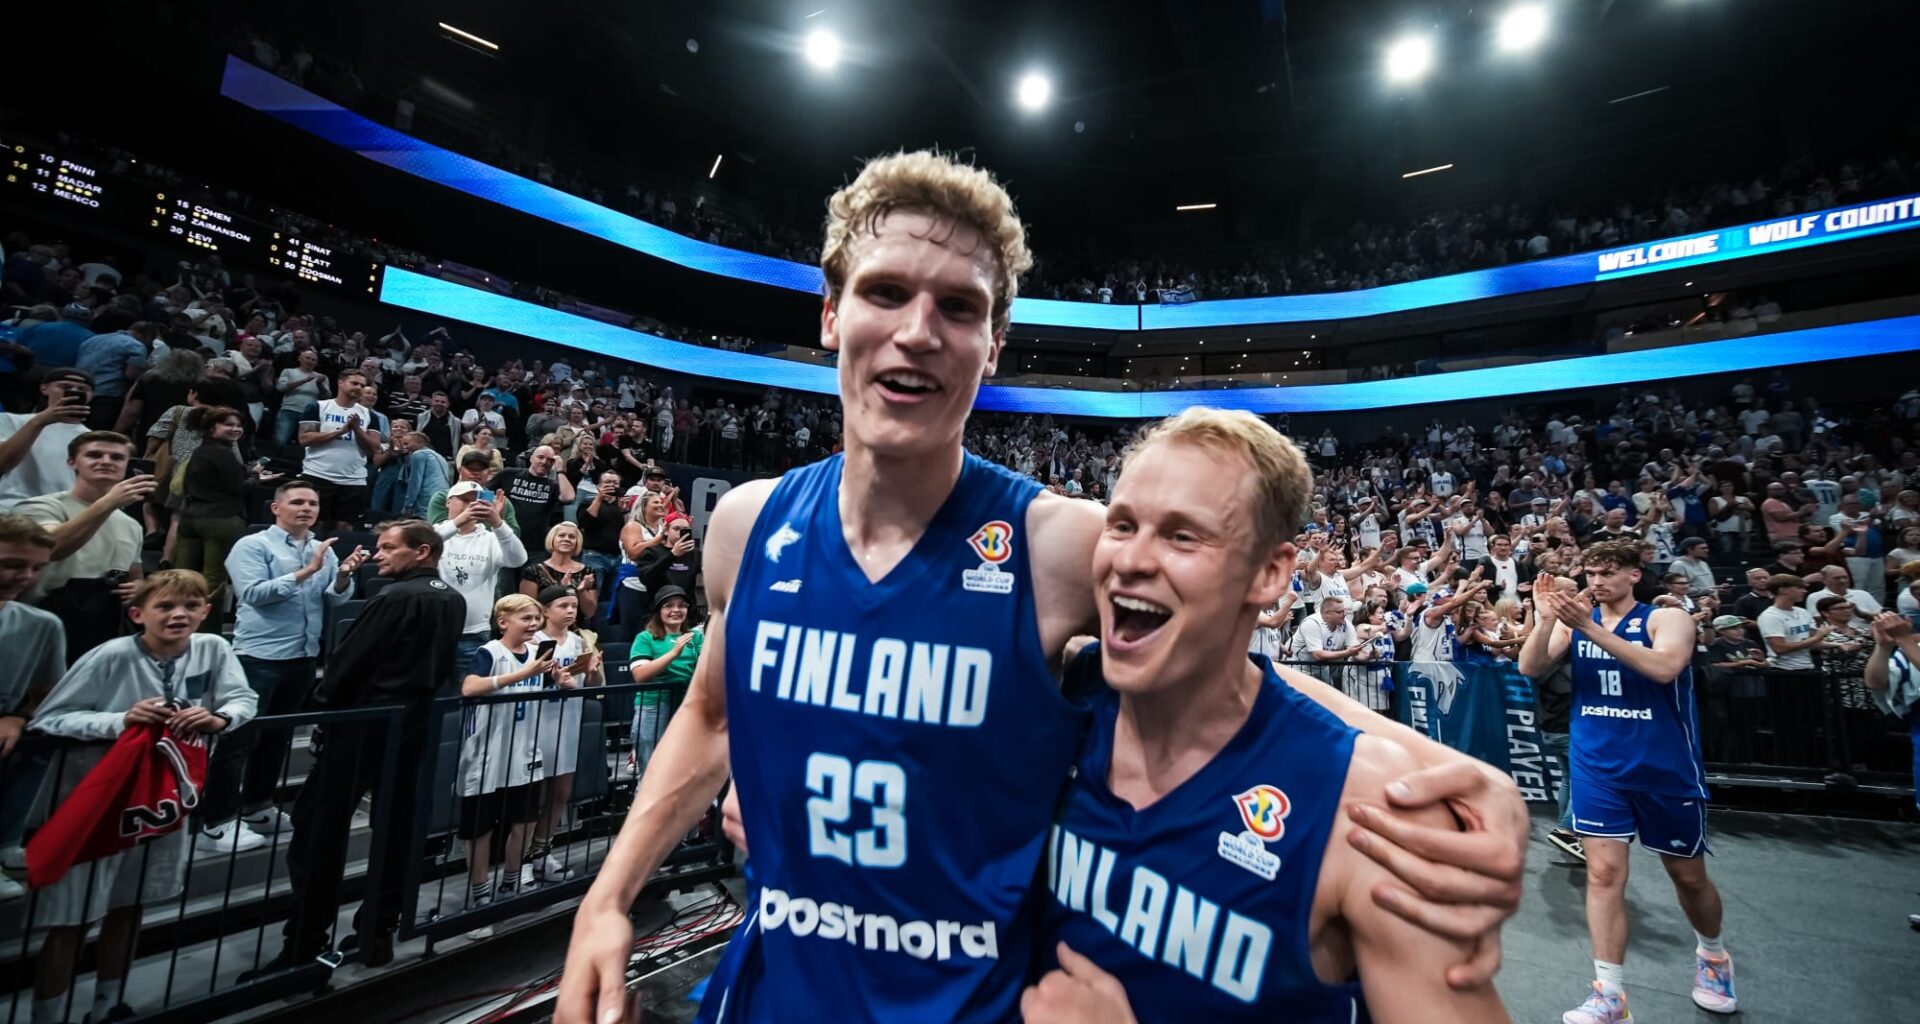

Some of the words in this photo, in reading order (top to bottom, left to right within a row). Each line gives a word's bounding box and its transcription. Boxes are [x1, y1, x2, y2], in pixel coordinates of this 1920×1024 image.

[13, 160, 29, 170] 14
[40, 153, 55, 163] 10
[61, 160, 96, 177] PNINI
[32, 182, 48, 192] 12
[53, 189, 100, 208] MENCO
[36, 168, 50, 177] 11
[57, 174, 103, 194] MADAR
[155, 206, 166, 215] 11
[176, 200, 190, 209] 15
[194, 205, 232, 223] COHEN
[170, 225, 184, 235] 30
[188, 231, 213, 243] LEVI
[172, 212, 187, 222] 20
[191, 218, 251, 243] ZAIMANSON
[289, 238, 300, 246] 41
[304, 242, 332, 256] GINAT
[1599, 233, 1719, 272] WELCOME
[1748, 214, 1821, 246] WOLF
[286, 250, 298, 258] 45
[302, 254, 331, 268] BLATT
[299, 266, 342, 284] ZOOSMAN
[325, 413, 364, 426] FINLD
[510, 486, 550, 499] ARMOUR
[750, 620, 993, 727] FINLAND
[1597, 669, 1623, 696] 18
[1408, 686, 1431, 738] FINL
[1581, 705, 1653, 720] postnord
[1506, 708, 1548, 801] PLAYER
[806, 752, 908, 867] 23
[758, 886, 999, 961] postnord
[1048, 823, 1274, 1004] INLAND
